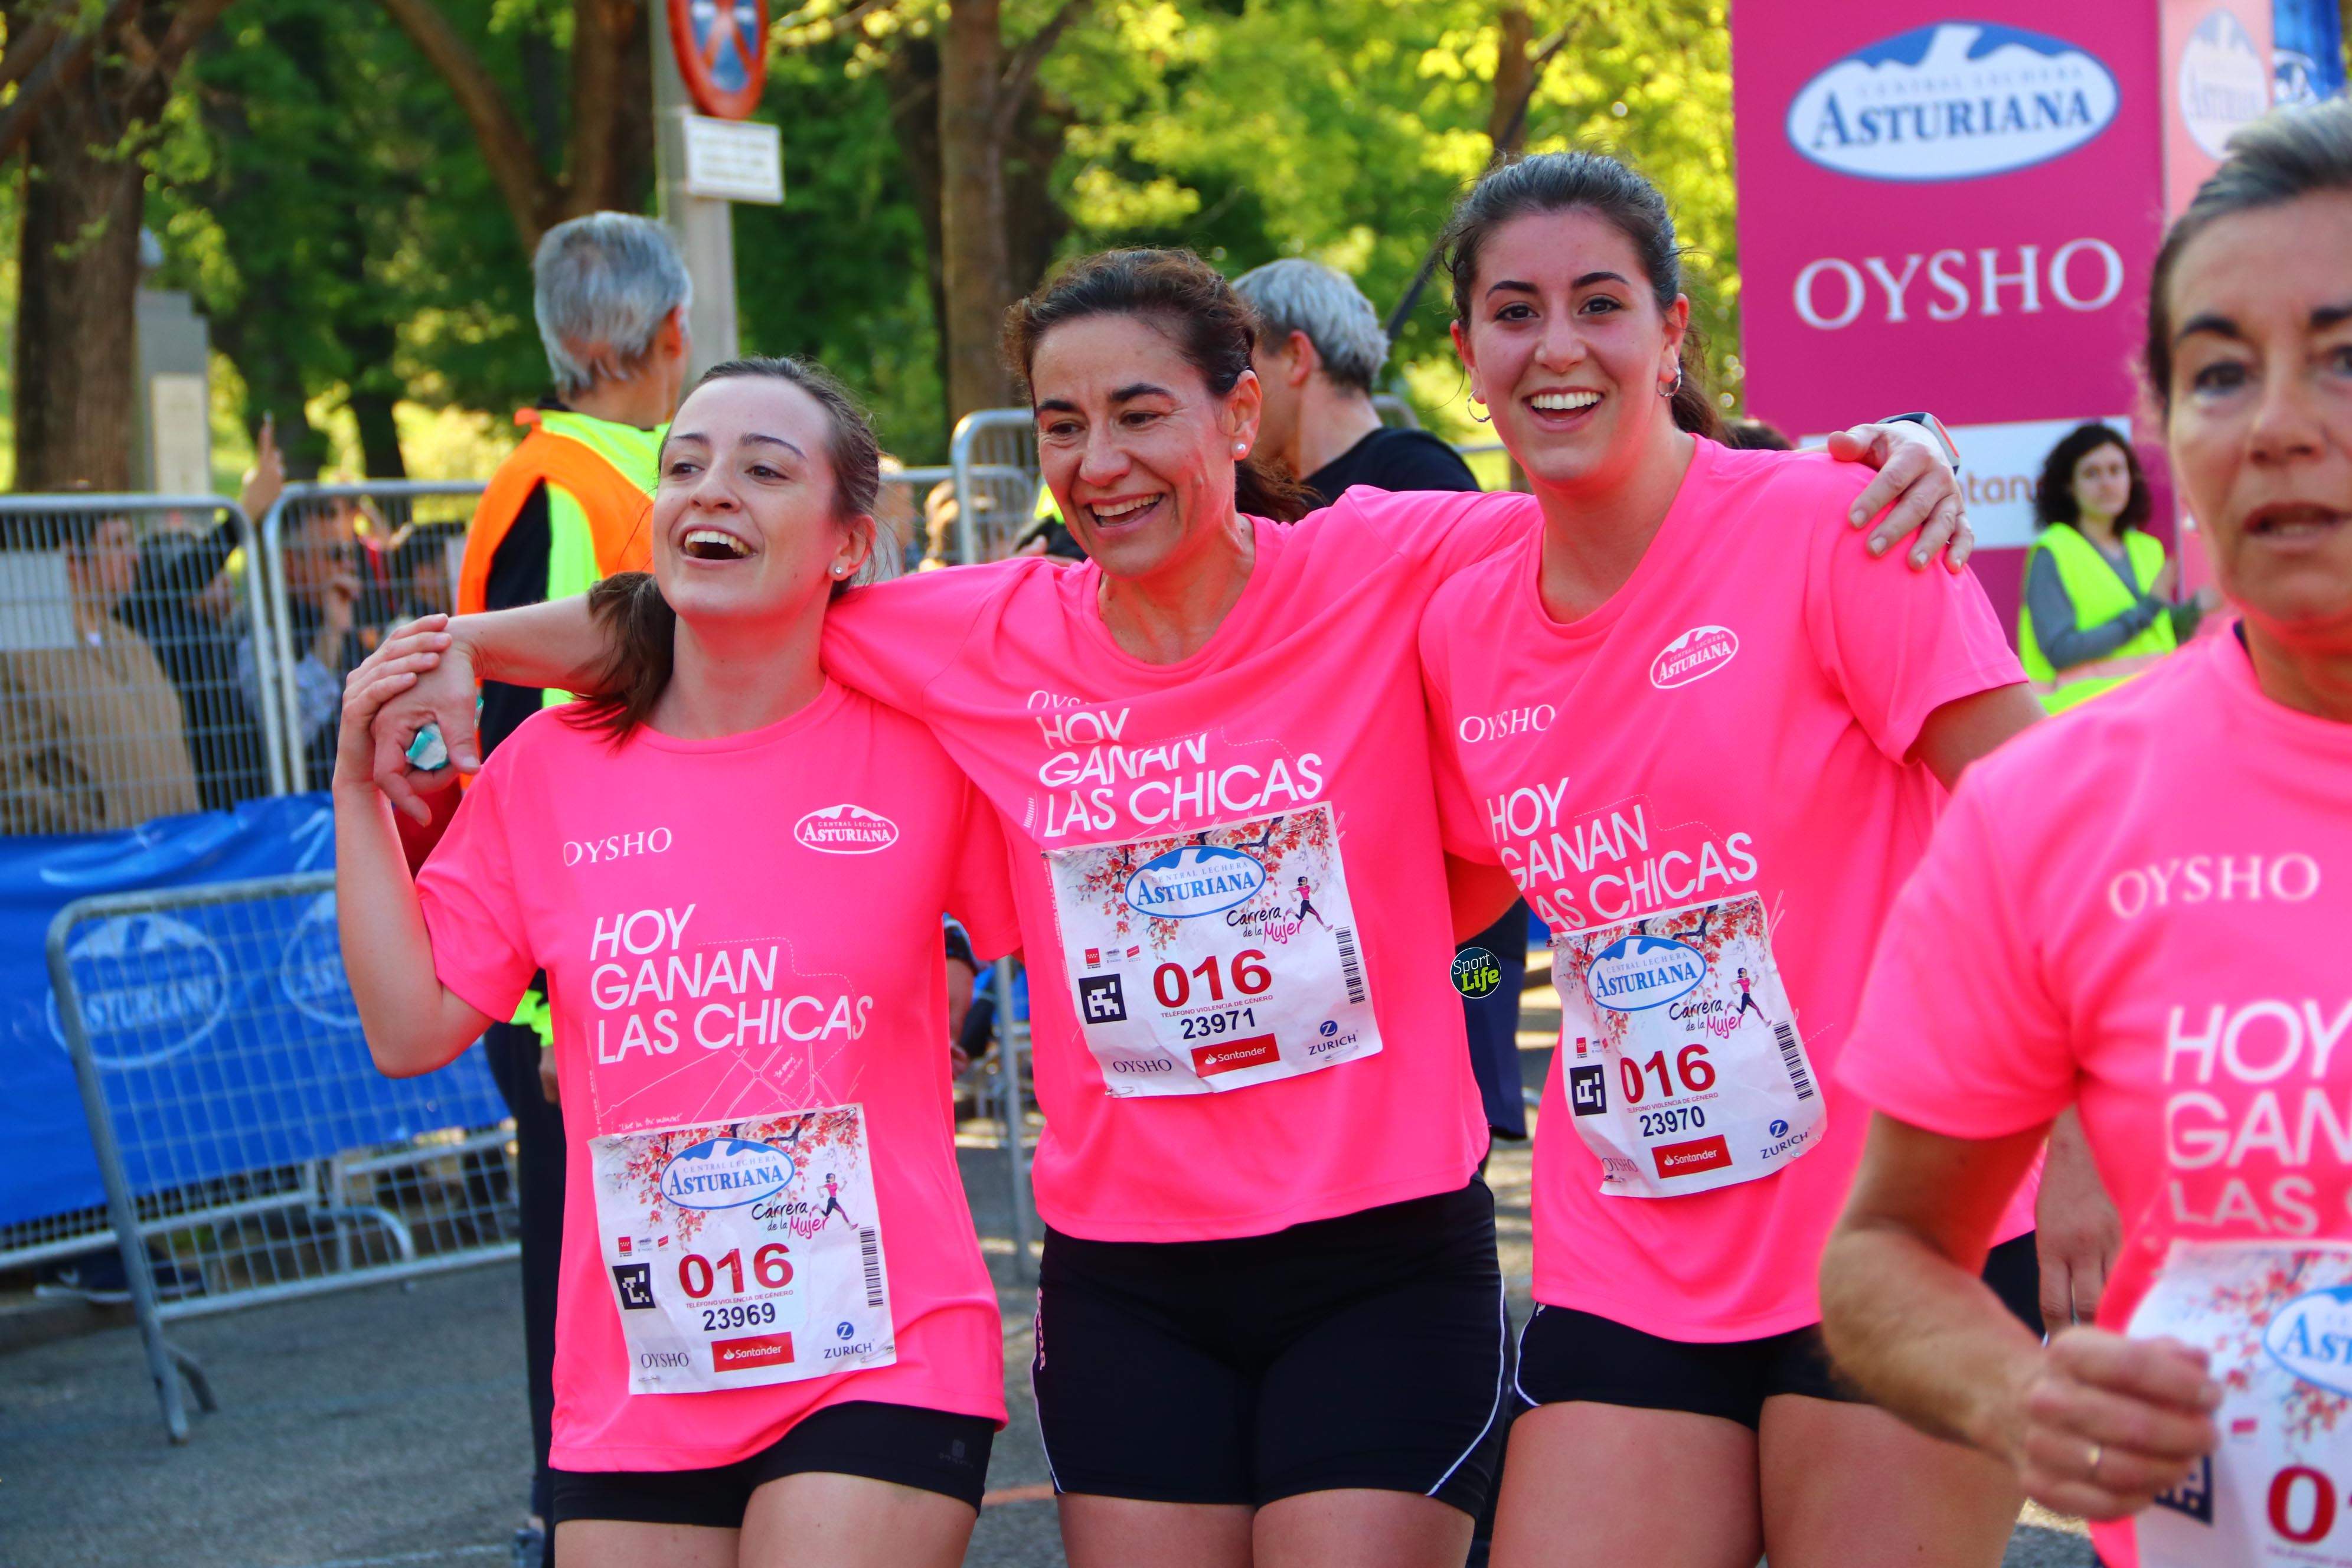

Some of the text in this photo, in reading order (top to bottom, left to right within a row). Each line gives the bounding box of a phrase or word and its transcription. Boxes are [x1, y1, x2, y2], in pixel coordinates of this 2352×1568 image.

[1811, 86, 2093, 149] ASTURIANA
[1793, 239, 2124, 329] OYSHO
[1657, 641, 1732, 683] ASTURIANA
[1459, 704, 1556, 743] OYSHO
[1038, 733, 1208, 788] GANAN
[1044, 753, 1322, 838] LAS CHICAS
[1487, 776, 1569, 843] HOY
[563, 827, 672, 867] OYSHO
[803, 822, 892, 842] ASTURIANA
[1501, 804, 1648, 891] GANAN
[1136, 871, 1257, 906] ASTURIANA
[1152, 861, 1249, 884] CENTRAL LECHERA
[1536, 832, 1758, 930] AS CHICAS
[2108, 852, 2321, 920] OYSHO
[590, 904, 696, 961] HOY
[1226, 907, 1282, 927] Carrera
[1243, 916, 1304, 945] de la Mujer
[591, 946, 778, 1011] GANAN
[1153, 949, 1272, 1008] 016
[1606, 952, 1688, 973] CENTRAL LECHERA
[1596, 962, 1698, 999] ASTURIANA
[1161, 1008, 1195, 1018] TELÉFONO
[1197, 1003, 1233, 1014] VIOLENCIA
[1244, 994, 1273, 1005] GÉNERO
[1669, 998, 1723, 1021] Carrera
[598, 995, 873, 1065] LAS CHICAS
[1181, 1007, 1255, 1040] 23971
[1686, 1010, 1746, 1039] de la Mujer
[1217, 1046, 1266, 1063] Santander
[1308, 1033, 1357, 1056] ZURICH
[2162, 998, 2352, 1086] HOY
[1113, 1059, 1172, 1073] OYSHO
[1620, 1043, 1716, 1104] 016
[1652, 1100, 1682, 1110] VIOLENCIA
[1691, 1092, 1719, 1102] GÉNERO
[1639, 1105, 1705, 1137] 23970
[1674, 1149, 1717, 1165] Santander
[1760, 1131, 1809, 1159] ZURICH
[668, 1164, 785, 1197] ASTURIANA
[683, 1155, 777, 1174] CENTRAL LECHERA
[1602, 1157, 1639, 1172] OYSHO
[752, 1202, 808, 1220] Carrera
[2169, 1176, 2319, 1238] LAS
[767, 1211, 830, 1239] de la Mujer
[678, 1243, 794, 1299] 016
[685, 1299, 718, 1309] TELÉFONO
[718, 1296, 753, 1305] VIOLENCIA
[765, 1290, 794, 1299] GÉNERO
[702, 1302, 776, 1331] 23969
[641, 1352, 690, 1369] OYSHO
[735, 1345, 782, 1358] Santander
[824, 1342, 873, 1359] ZURICH
